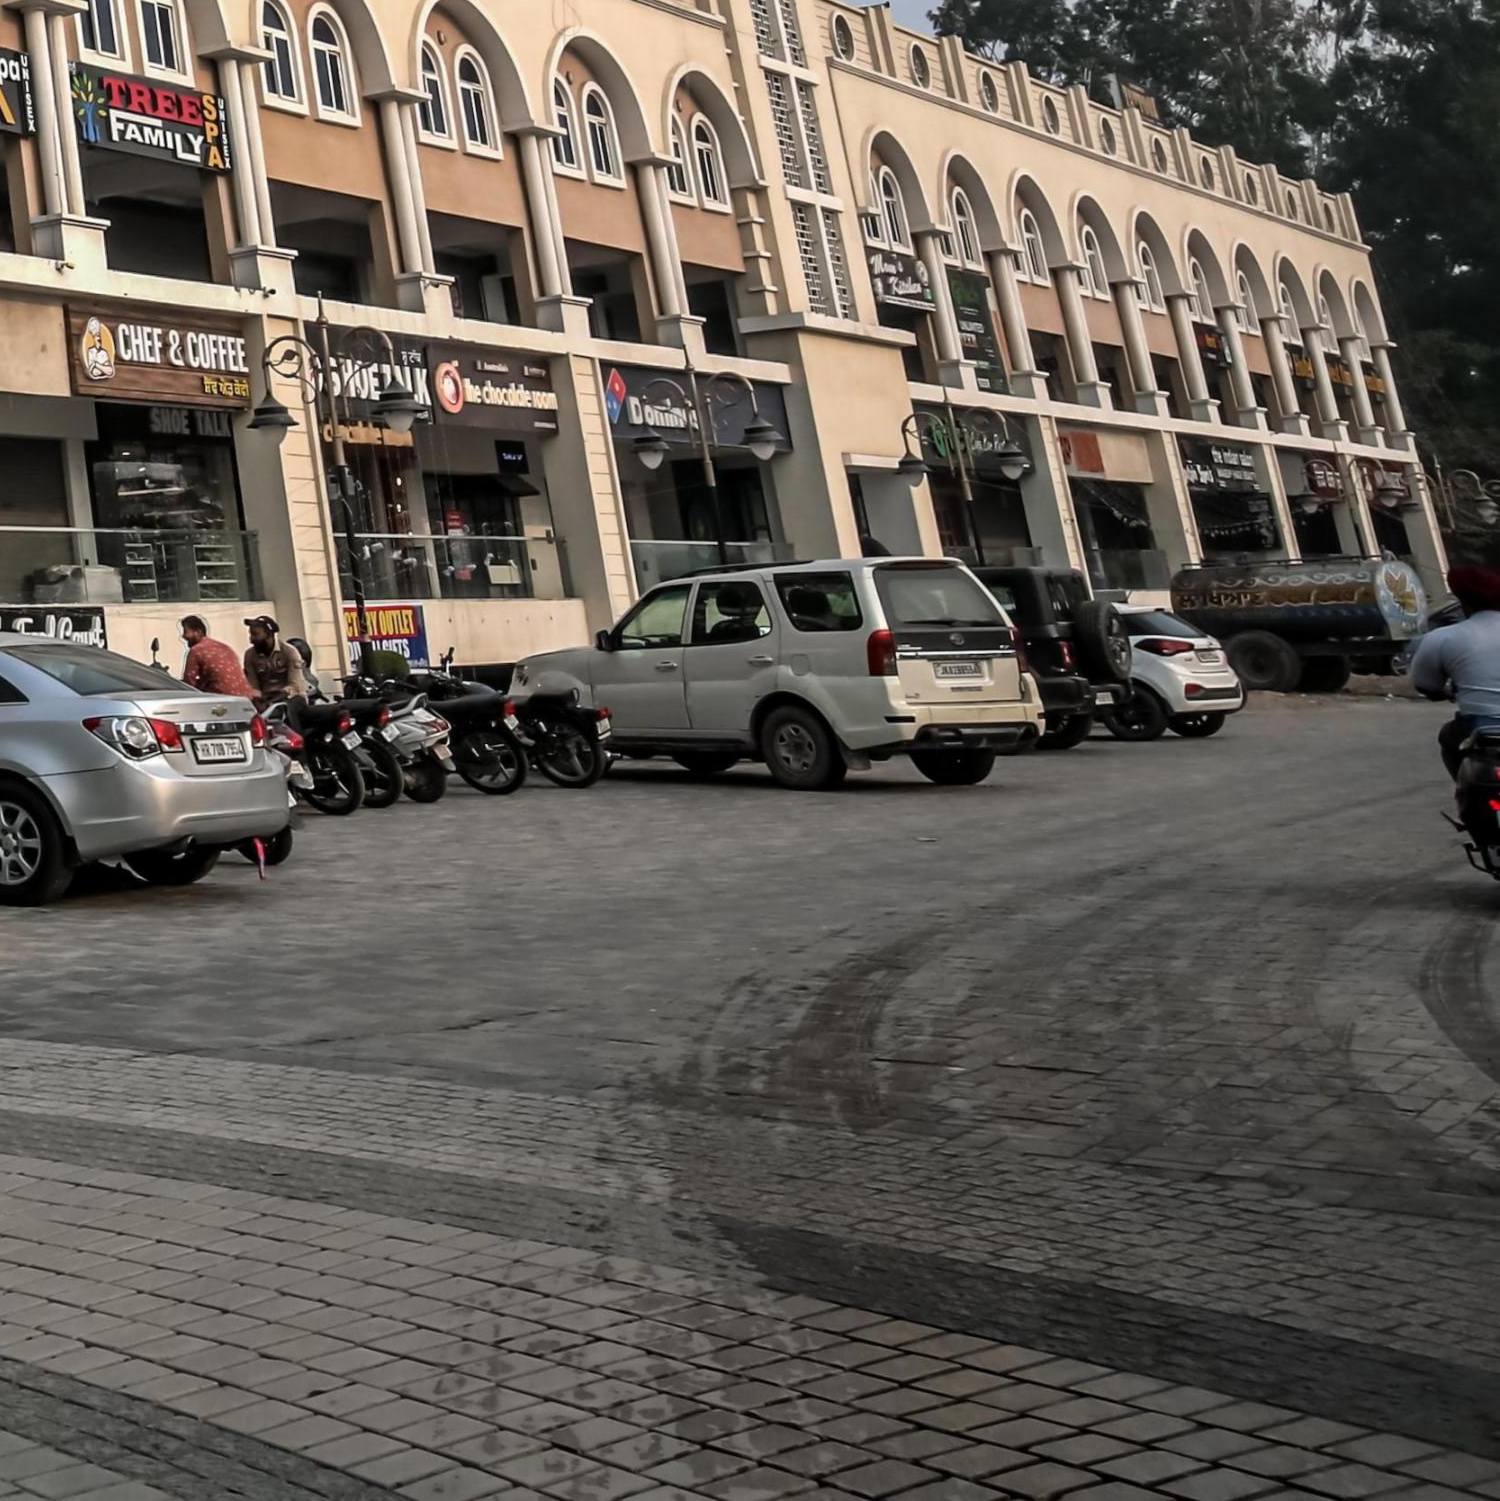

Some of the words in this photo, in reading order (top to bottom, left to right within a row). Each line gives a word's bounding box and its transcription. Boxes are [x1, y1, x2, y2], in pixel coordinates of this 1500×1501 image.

[19, 53, 37, 133] UNISEX
[102, 75, 205, 127] TREE
[108, 108, 205, 163] FAMILY
[201, 94, 225, 169] SPA
[217, 97, 232, 170] UNISEX
[117, 322, 163, 364] CHEF
[168, 329, 186, 367] &
[185, 330, 250, 373] COFFEE
[150, 407, 191, 435] SHOE
[482, 379, 532, 409] chocolate
[531, 390, 559, 411] room
[378, 609, 415, 636] OUTLET
